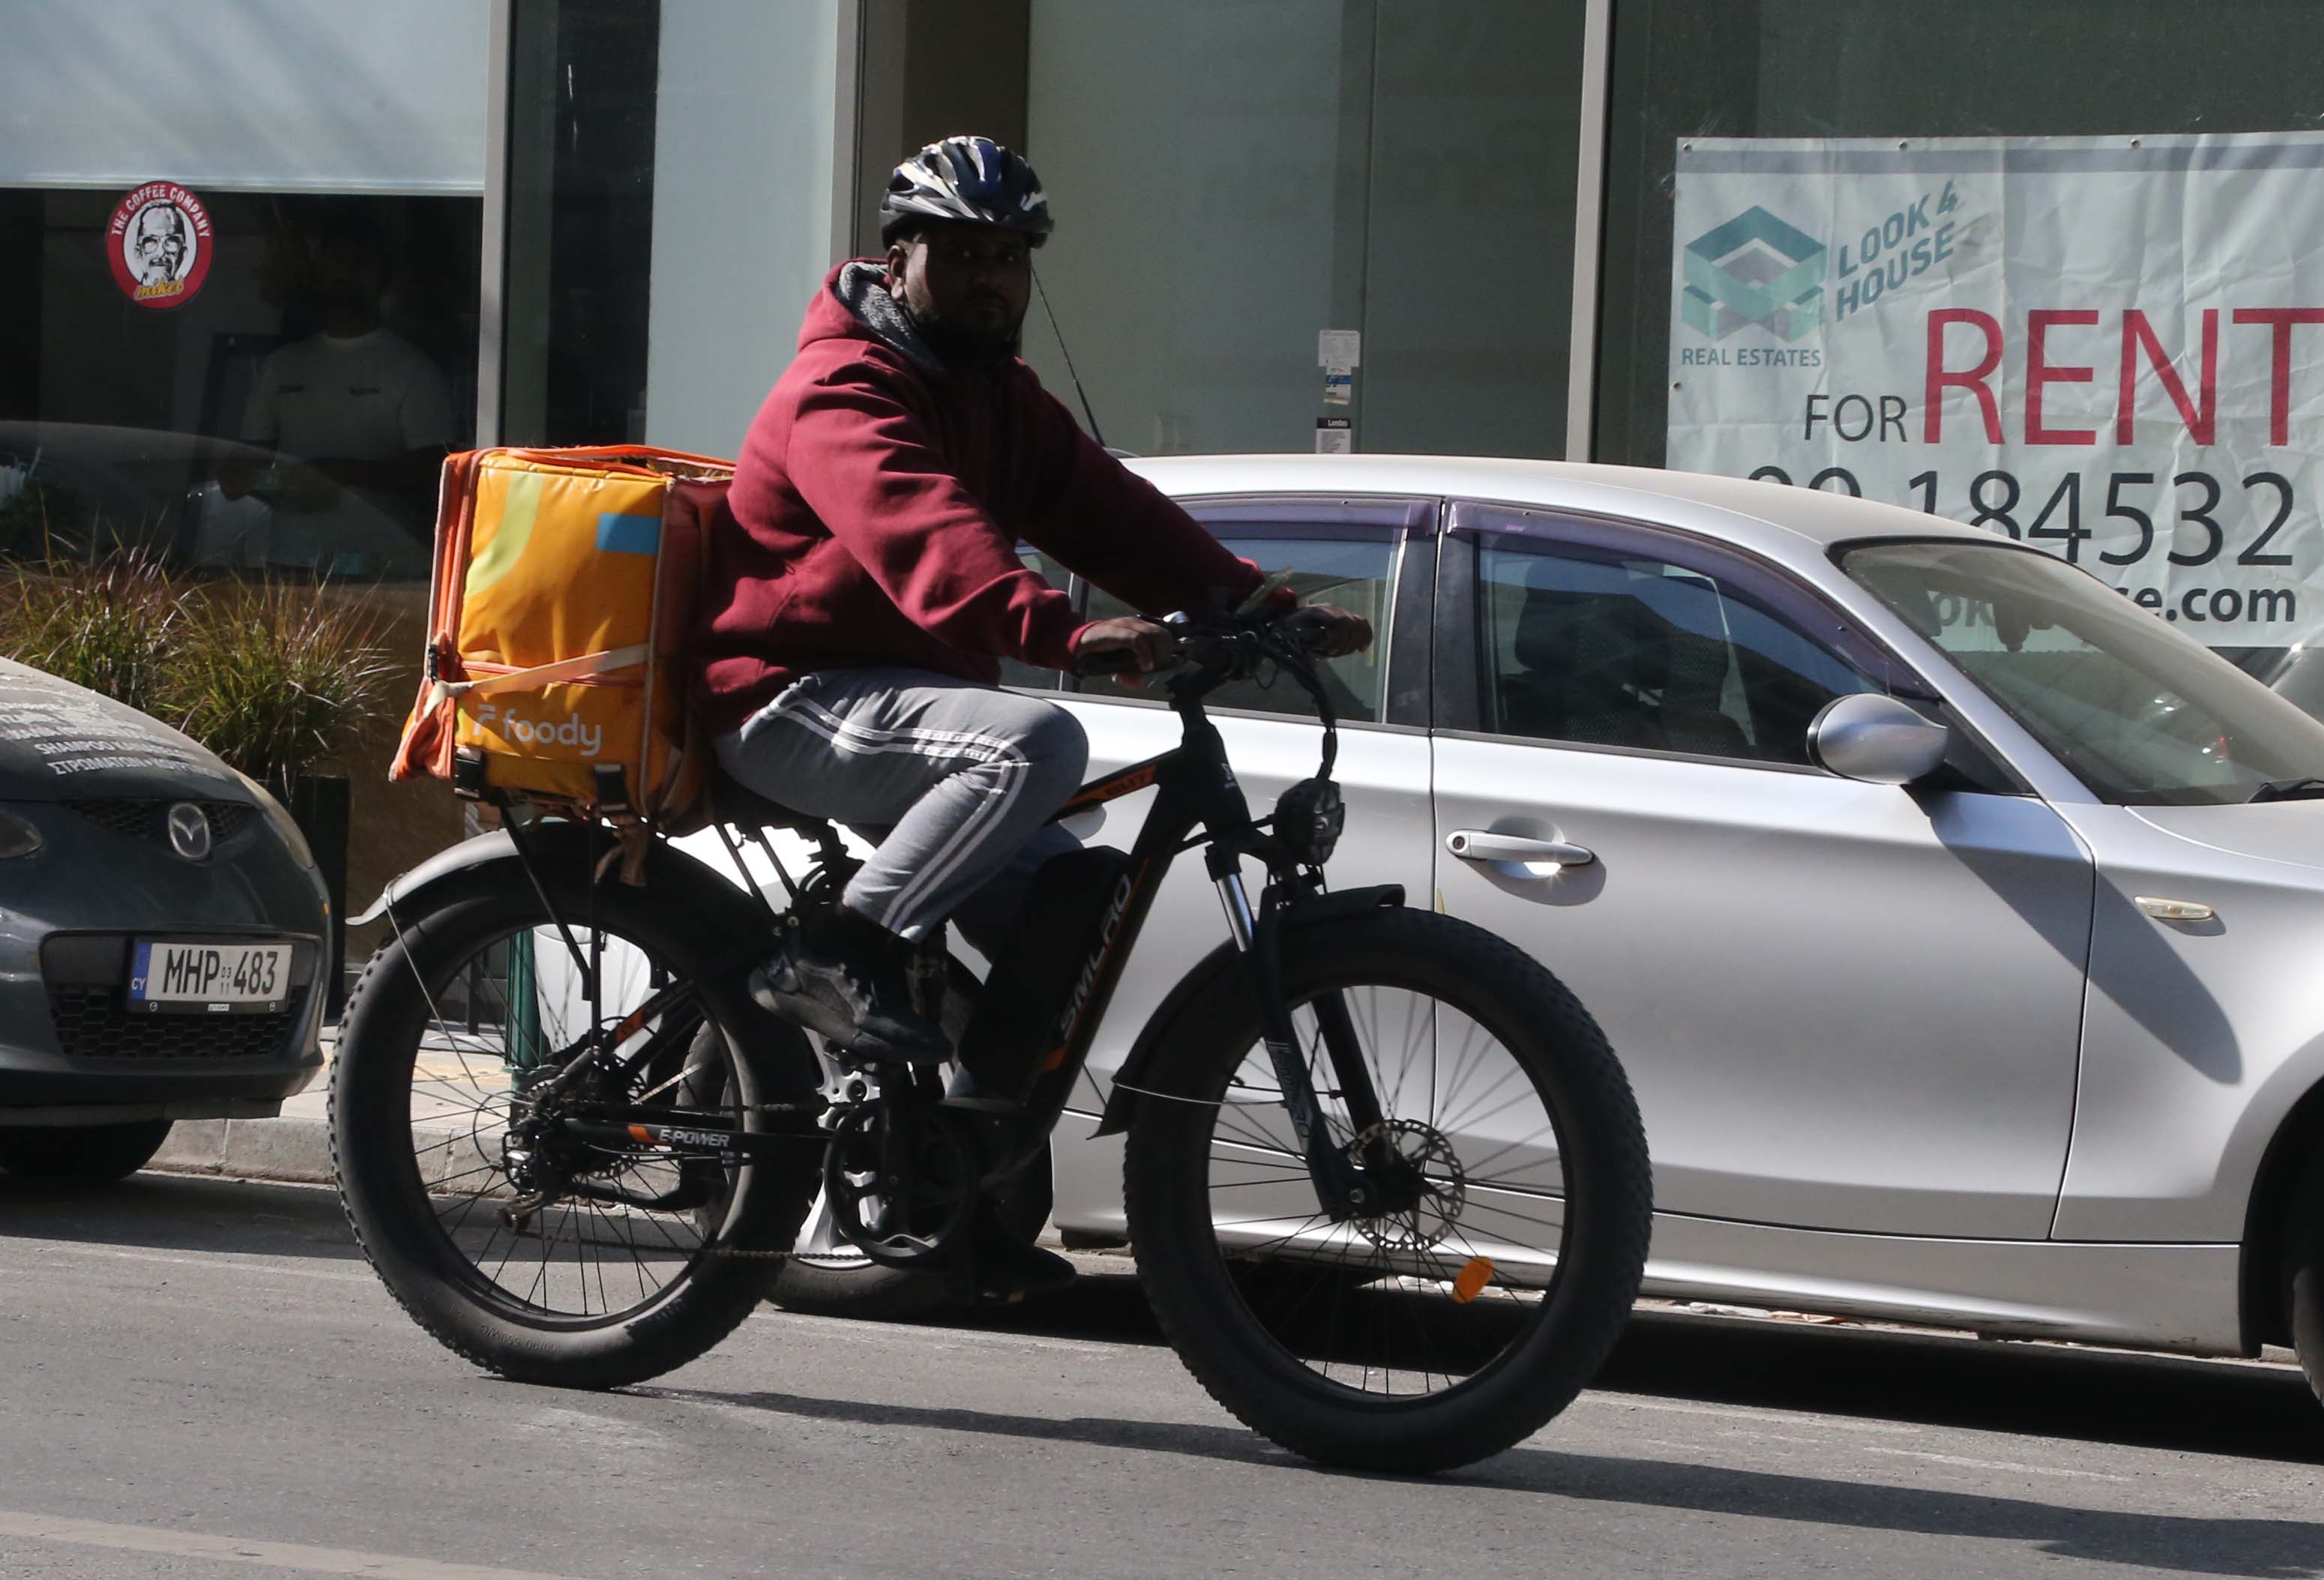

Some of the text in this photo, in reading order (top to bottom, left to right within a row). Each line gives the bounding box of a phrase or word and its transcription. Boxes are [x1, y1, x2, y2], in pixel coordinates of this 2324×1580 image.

[112, 185, 211, 238] THE COFFEE COMPANY
[1838, 179, 1959, 280] LOOK 4
[1837, 220, 1955, 323] HOUSE
[1682, 348, 1822, 367] REAL ESTATES
[1804, 308, 2324, 447] FOR RENT
[34, 741, 113, 756] SHAMPOO
[503, 708, 602, 756] foody
[131, 977, 147, 990] CY
[162, 949, 278, 995] MHP 483
